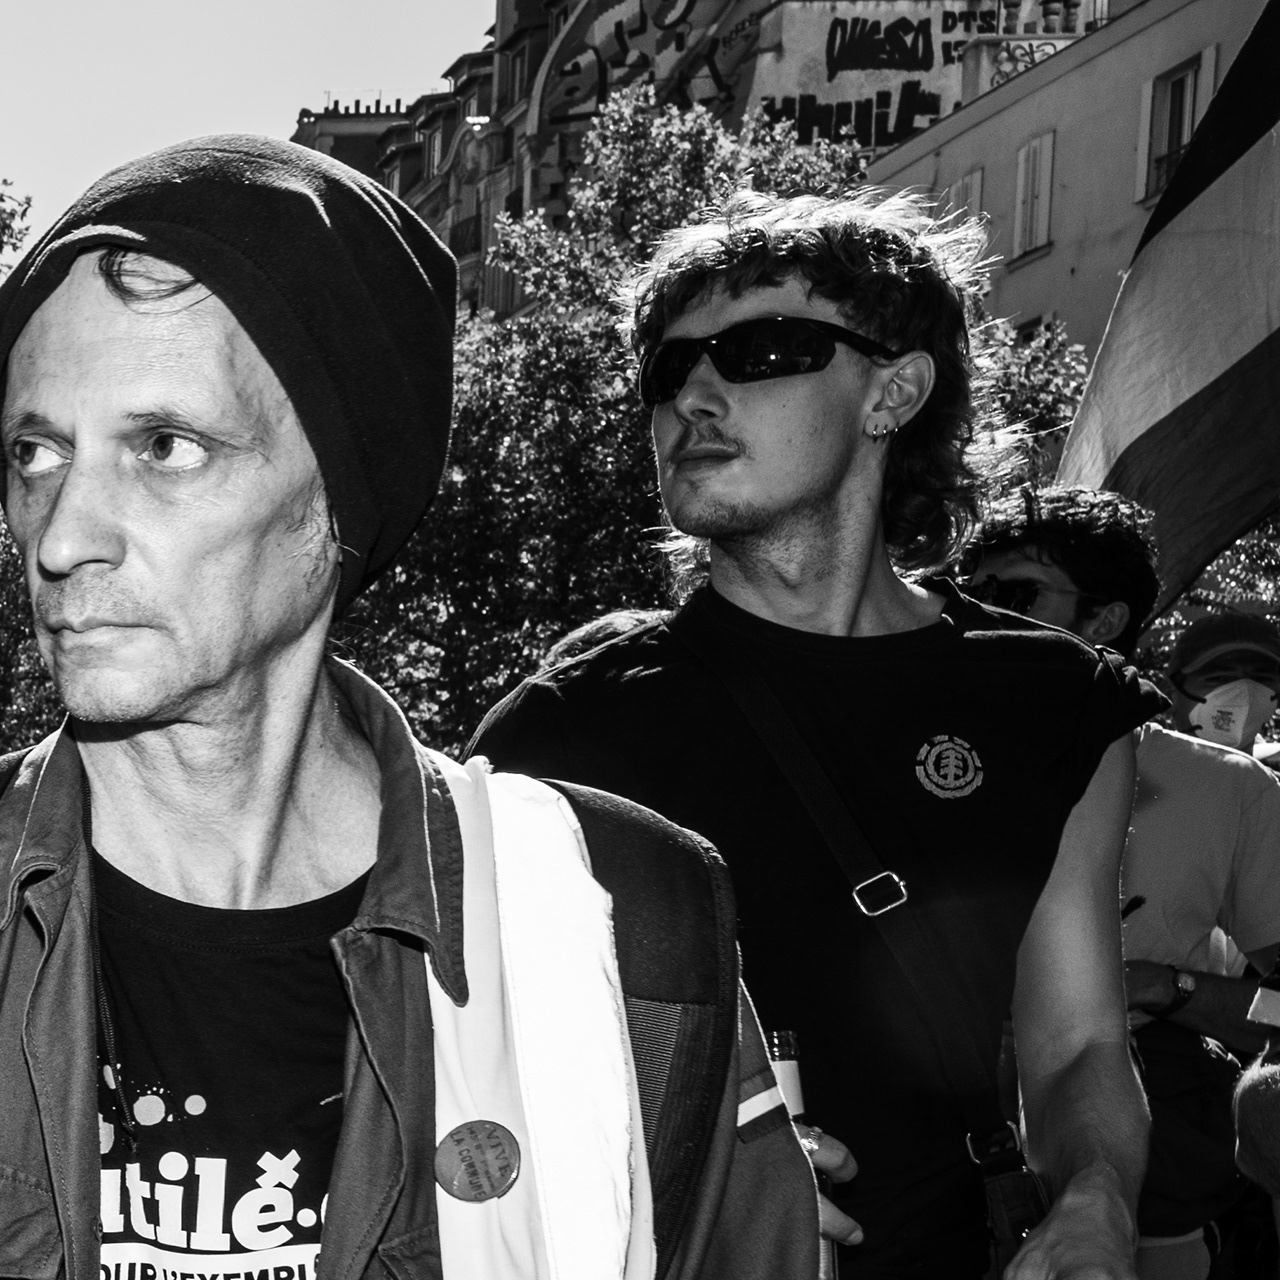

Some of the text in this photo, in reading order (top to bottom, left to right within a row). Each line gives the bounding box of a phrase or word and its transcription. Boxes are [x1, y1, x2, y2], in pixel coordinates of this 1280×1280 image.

[450, 1130, 465, 1146] LA
[458, 1148, 487, 1199] COMMUNE
[486, 1129, 511, 1177] VIVE
